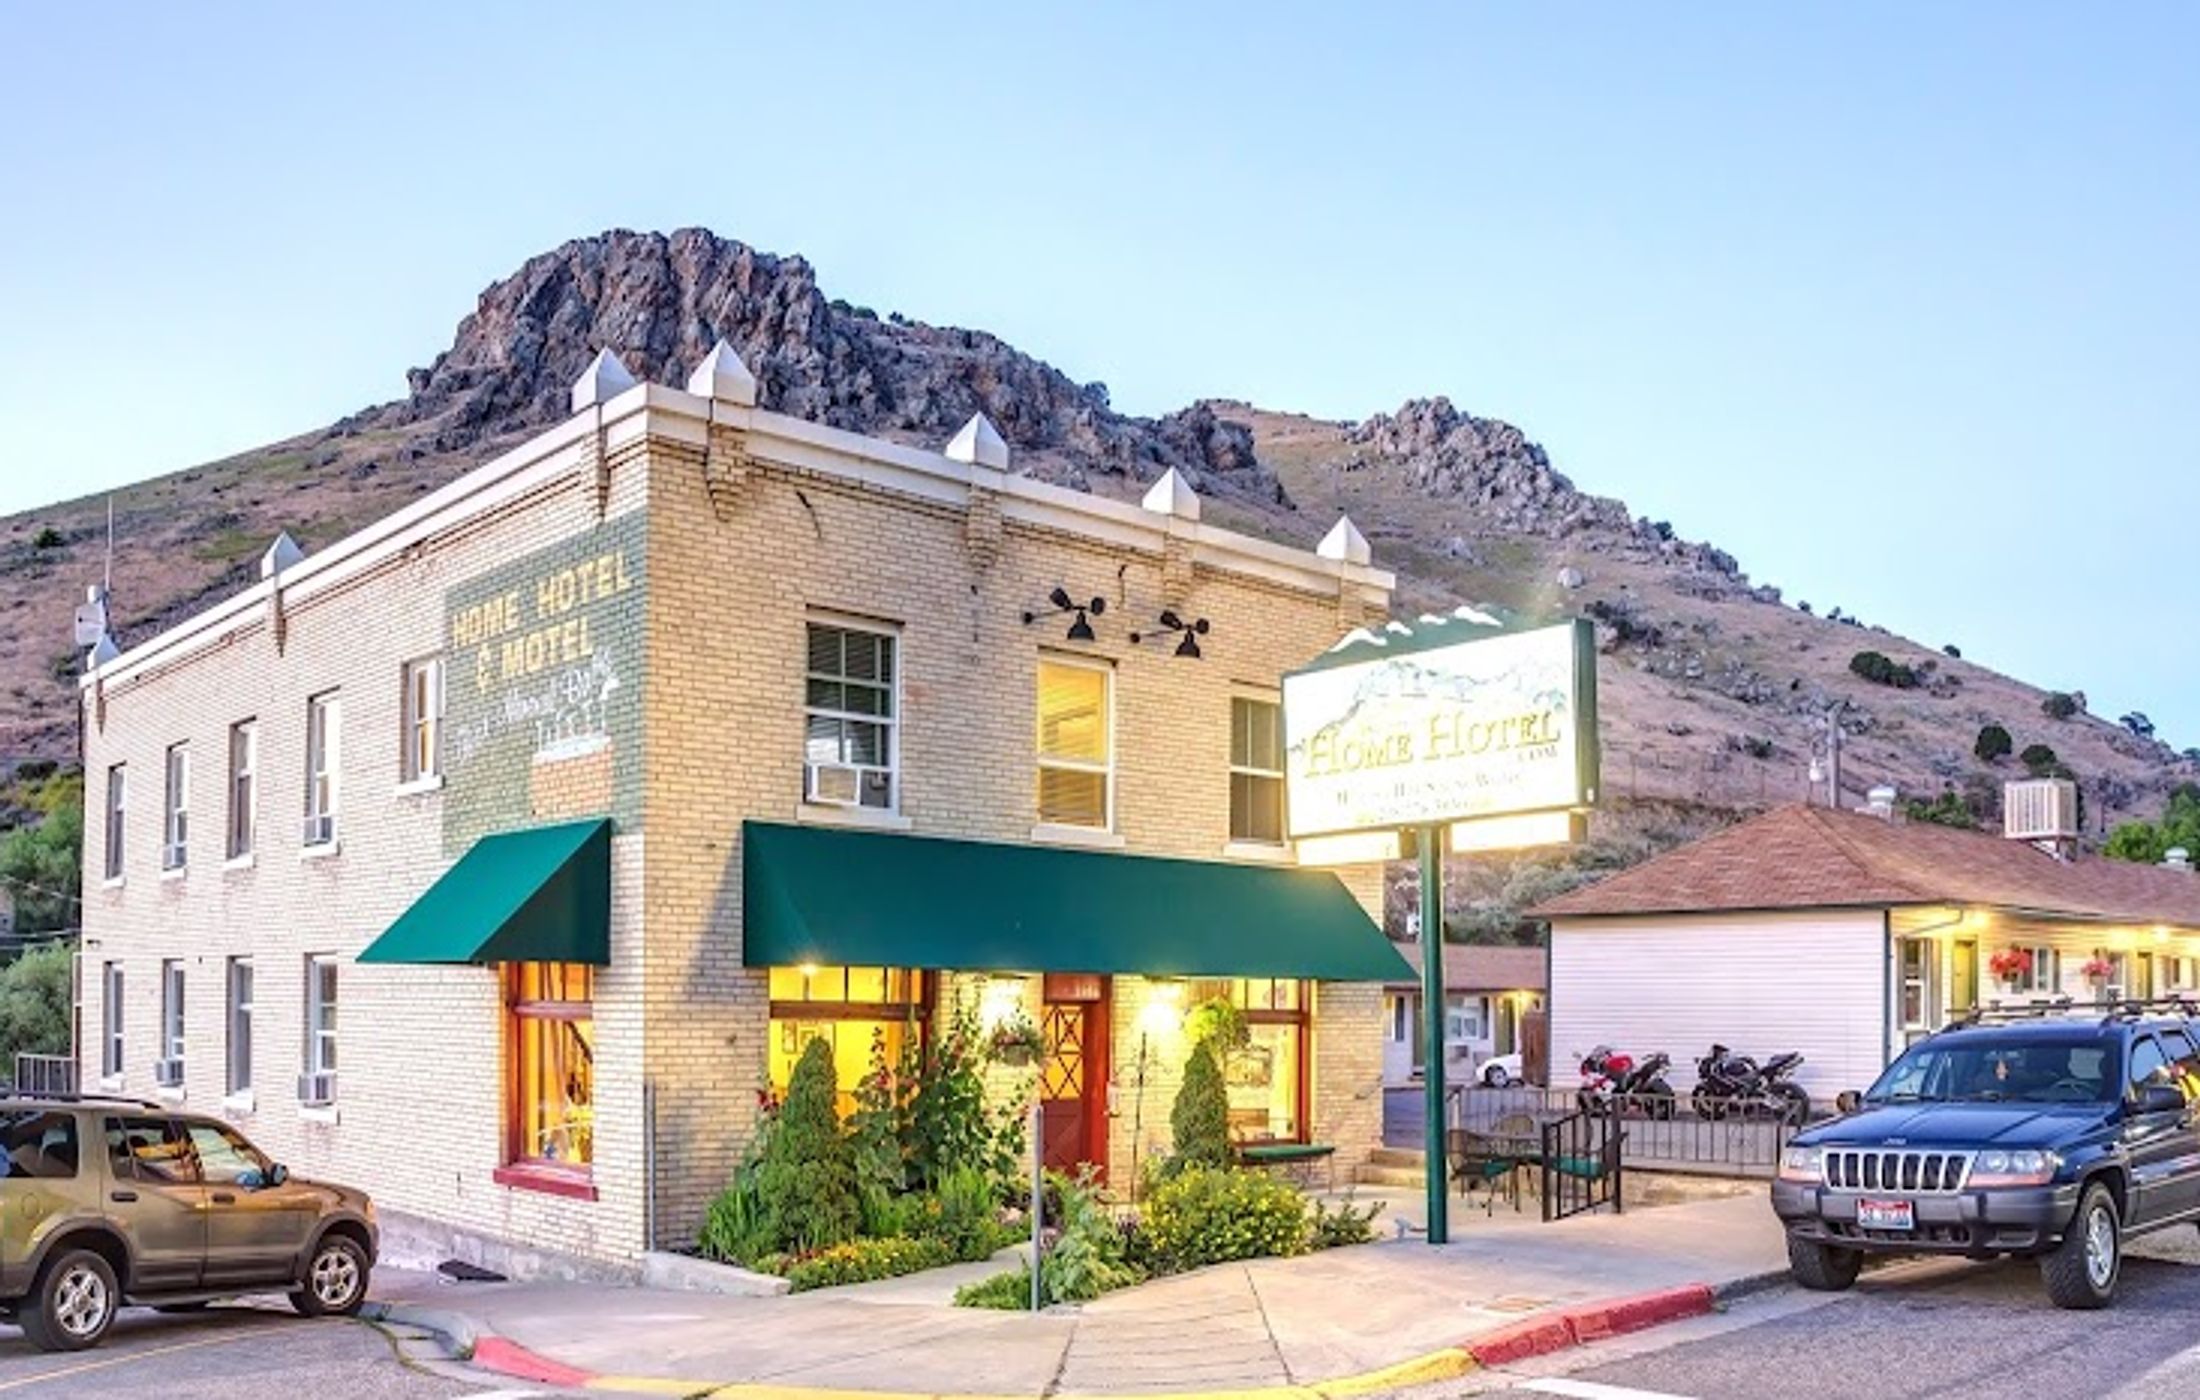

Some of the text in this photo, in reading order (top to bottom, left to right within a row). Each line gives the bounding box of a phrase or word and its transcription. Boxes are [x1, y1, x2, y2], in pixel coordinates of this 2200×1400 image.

[453, 550, 633, 650] HOME HOTEL
[501, 615, 594, 680] MOTEL
